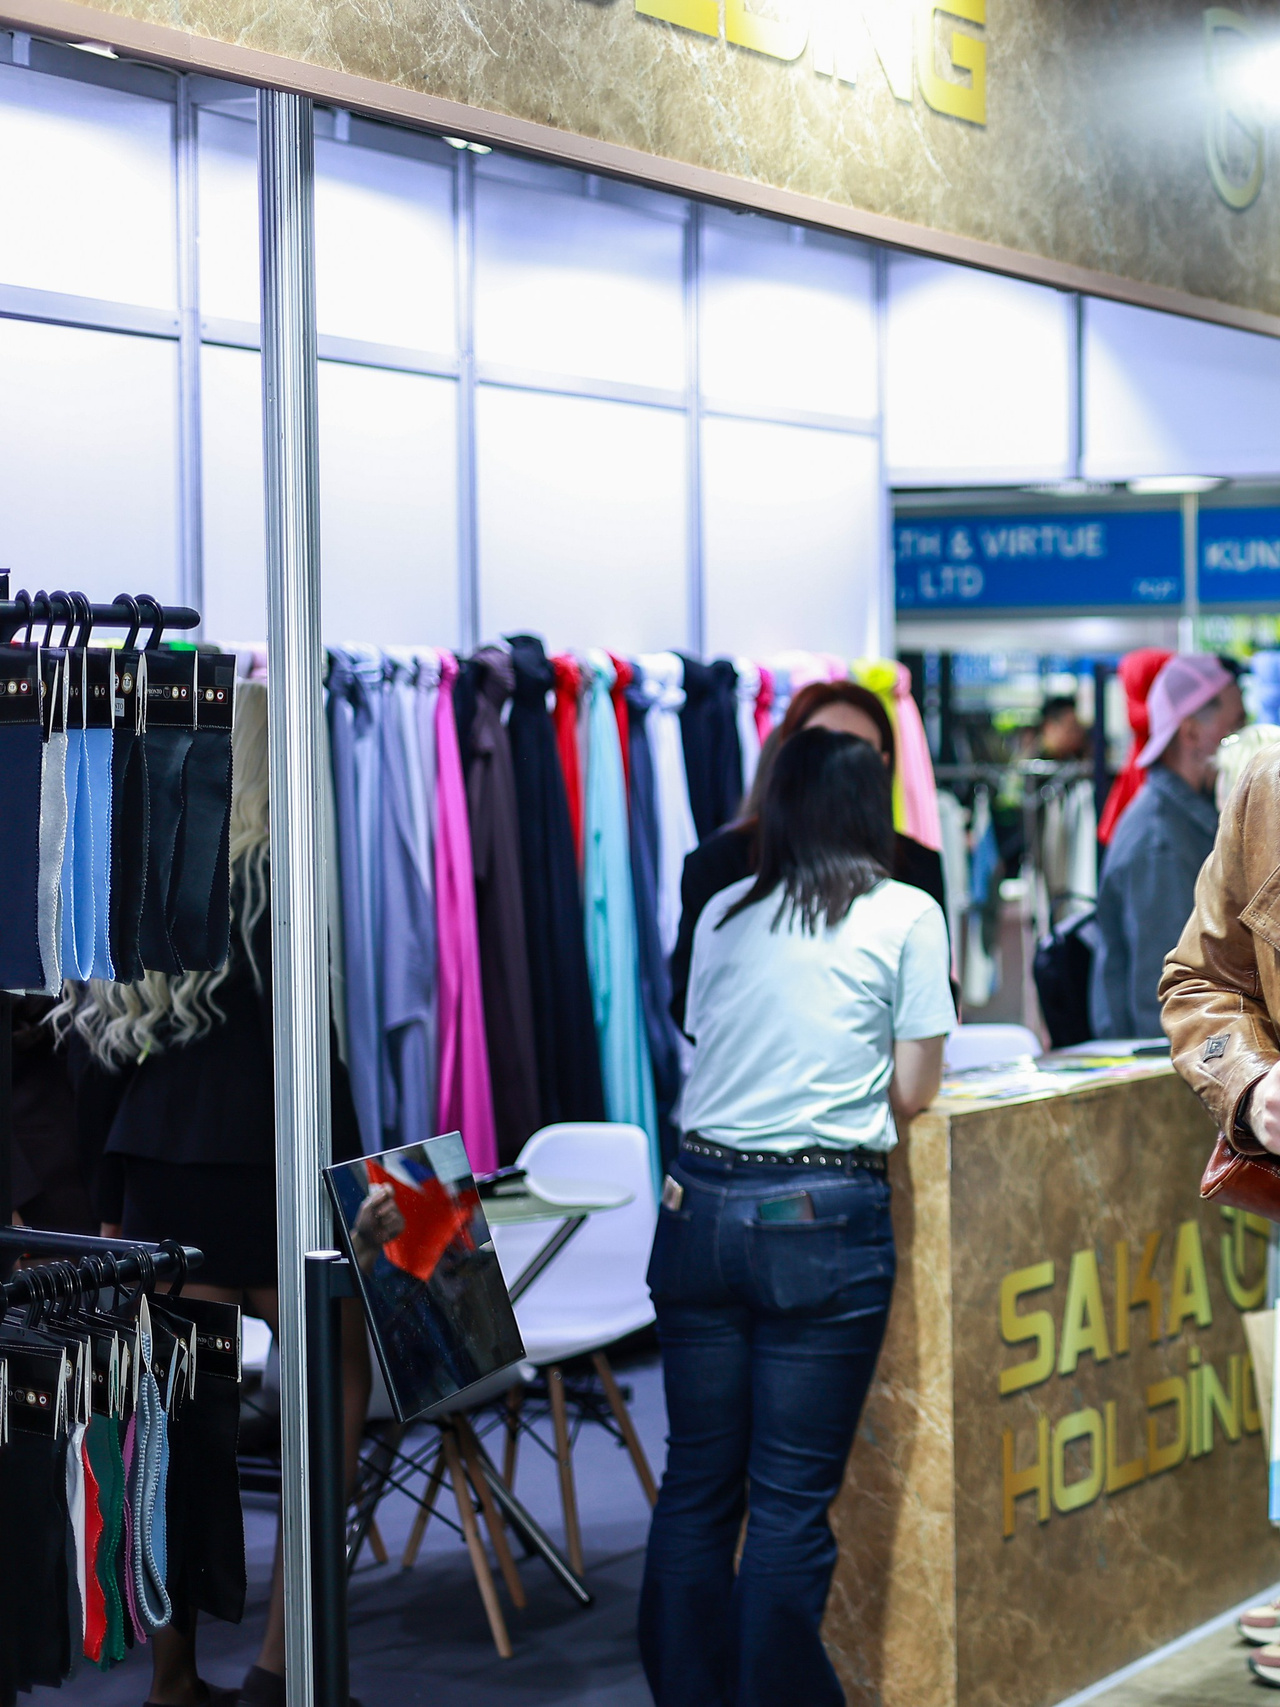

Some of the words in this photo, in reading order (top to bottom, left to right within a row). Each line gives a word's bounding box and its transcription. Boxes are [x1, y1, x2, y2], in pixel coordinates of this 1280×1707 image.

[897, 528, 941, 558] TH
[949, 527, 974, 560] &
[978, 522, 1106, 559] VIRTUE
[918, 564, 984, 600] LTD
[1000, 1219, 1213, 1396] SAKA
